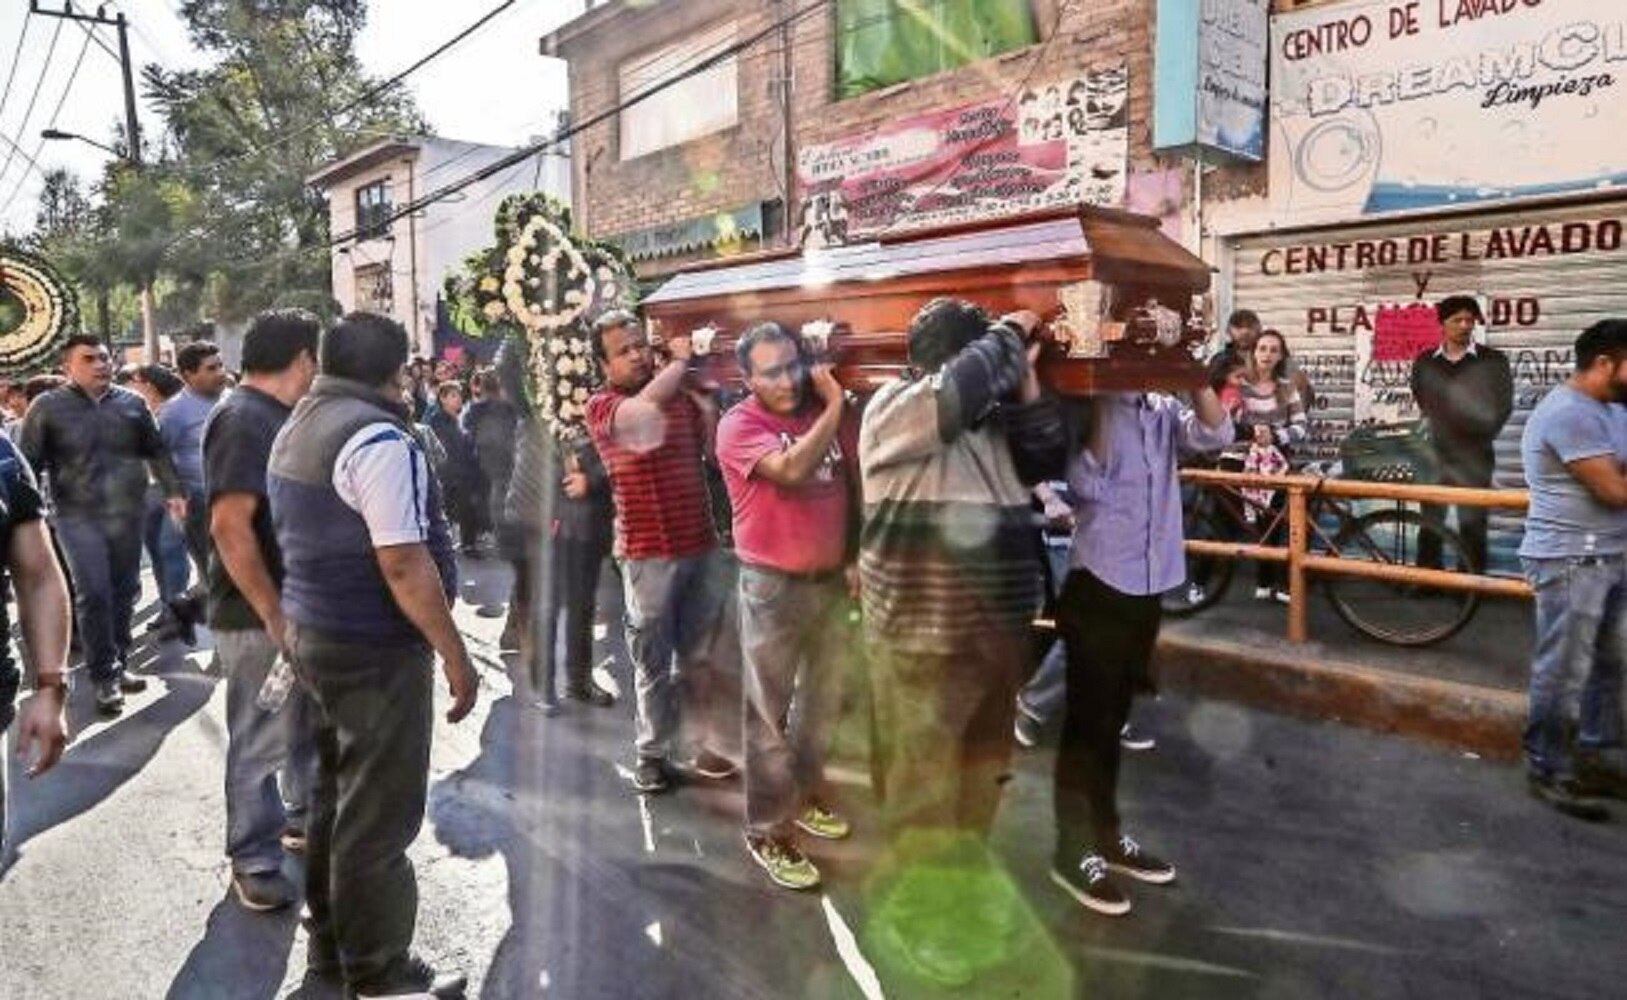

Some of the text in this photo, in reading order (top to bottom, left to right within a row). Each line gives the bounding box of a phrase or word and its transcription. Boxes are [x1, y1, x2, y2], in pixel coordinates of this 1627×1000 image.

[1283, 14, 1372, 62] CENTRO
[1388, 1, 1420, 40] DE
[1438, 0, 1541, 28] LAVA
[1480, 72, 1615, 110] Limpieza
[1261, 219, 1623, 276] CENTRO DE LAVADO
[1412, 271, 1433, 300] Y
[1306, 297, 1541, 336] PLADO
